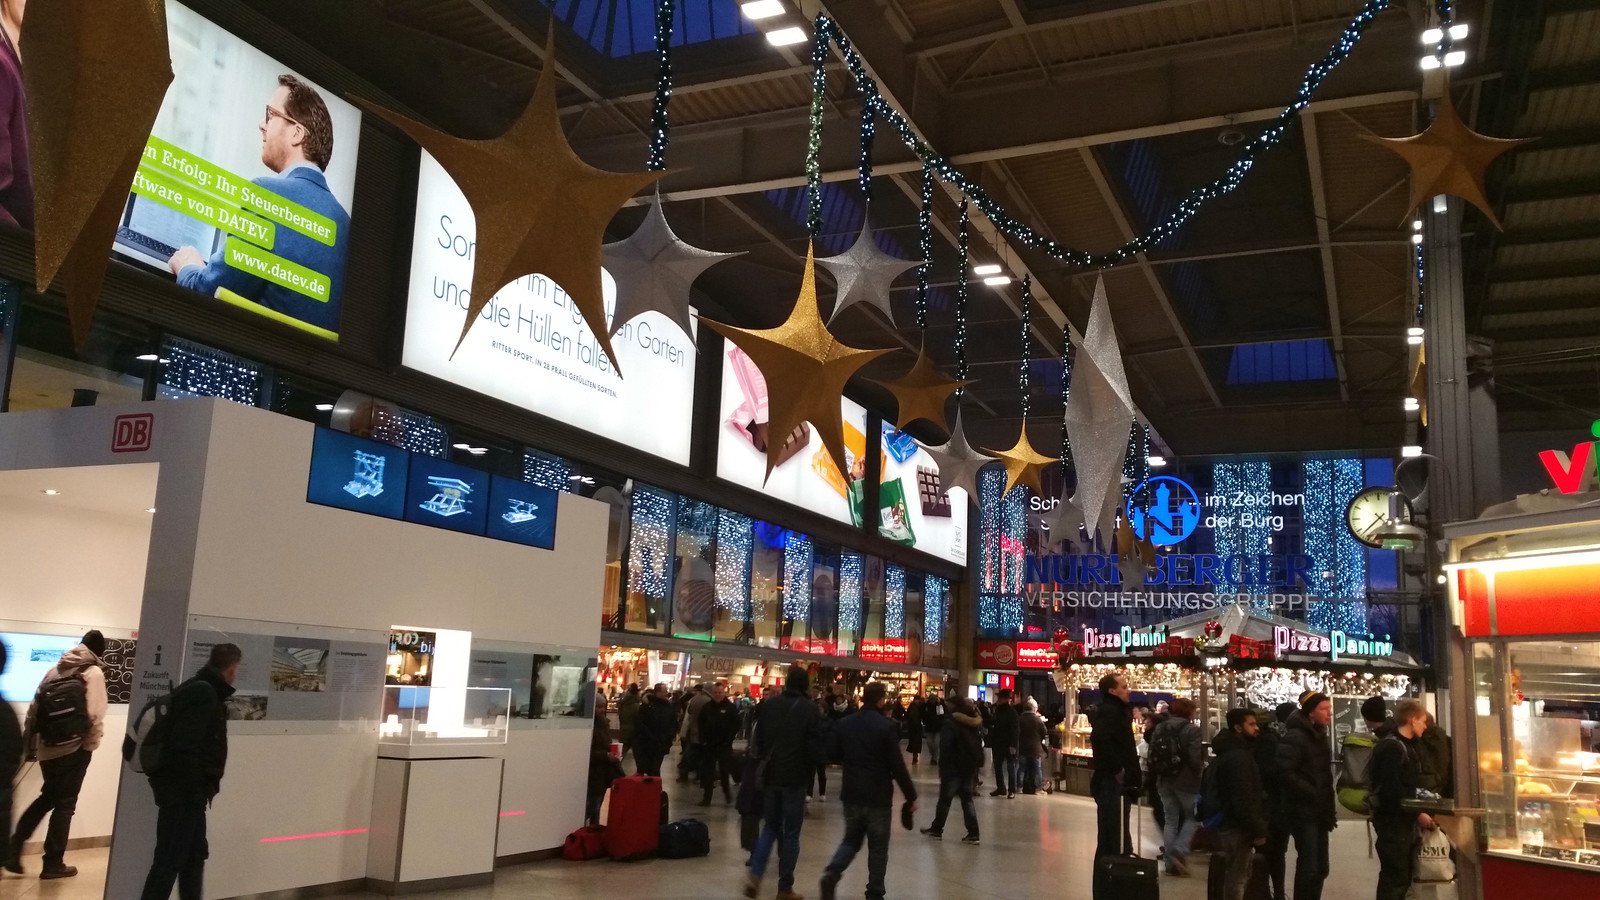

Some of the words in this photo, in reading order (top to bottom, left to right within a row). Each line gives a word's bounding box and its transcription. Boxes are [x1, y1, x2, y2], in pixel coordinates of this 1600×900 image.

[161, 149, 212, 186] Erfolg:
[216, 174, 238, 196] Ihr
[241, 187, 332, 239] Steuerberater
[187, 197, 214, 219] von
[218, 207, 269, 242] DATEV.
[232, 249, 325, 295] www.datev.de
[517, 303, 572, 357] Hüllen
[637, 321, 684, 368] Garten
[491, 340, 512, 355] RITTER
[513, 349, 534, 364] SPORT.
[535, 357, 542, 367] IN
[543, 361, 550, 371] 28
[551, 364, 568, 378] PRALL
[568, 372, 597, 390] GEFÜLLTEN
[597, 384, 618, 398] SORTEN.
[116, 419, 148, 447] DB
[1205, 492, 1226, 507] im
[1232, 491, 1306, 507] Zeichen
[1205, 513, 1236, 528] der
[1240, 512, 1284, 531] Burg
[1025, 591, 1319, 611] VERSICHERUNGSGRUPPE
[705, 656, 735, 671] GOSCH
